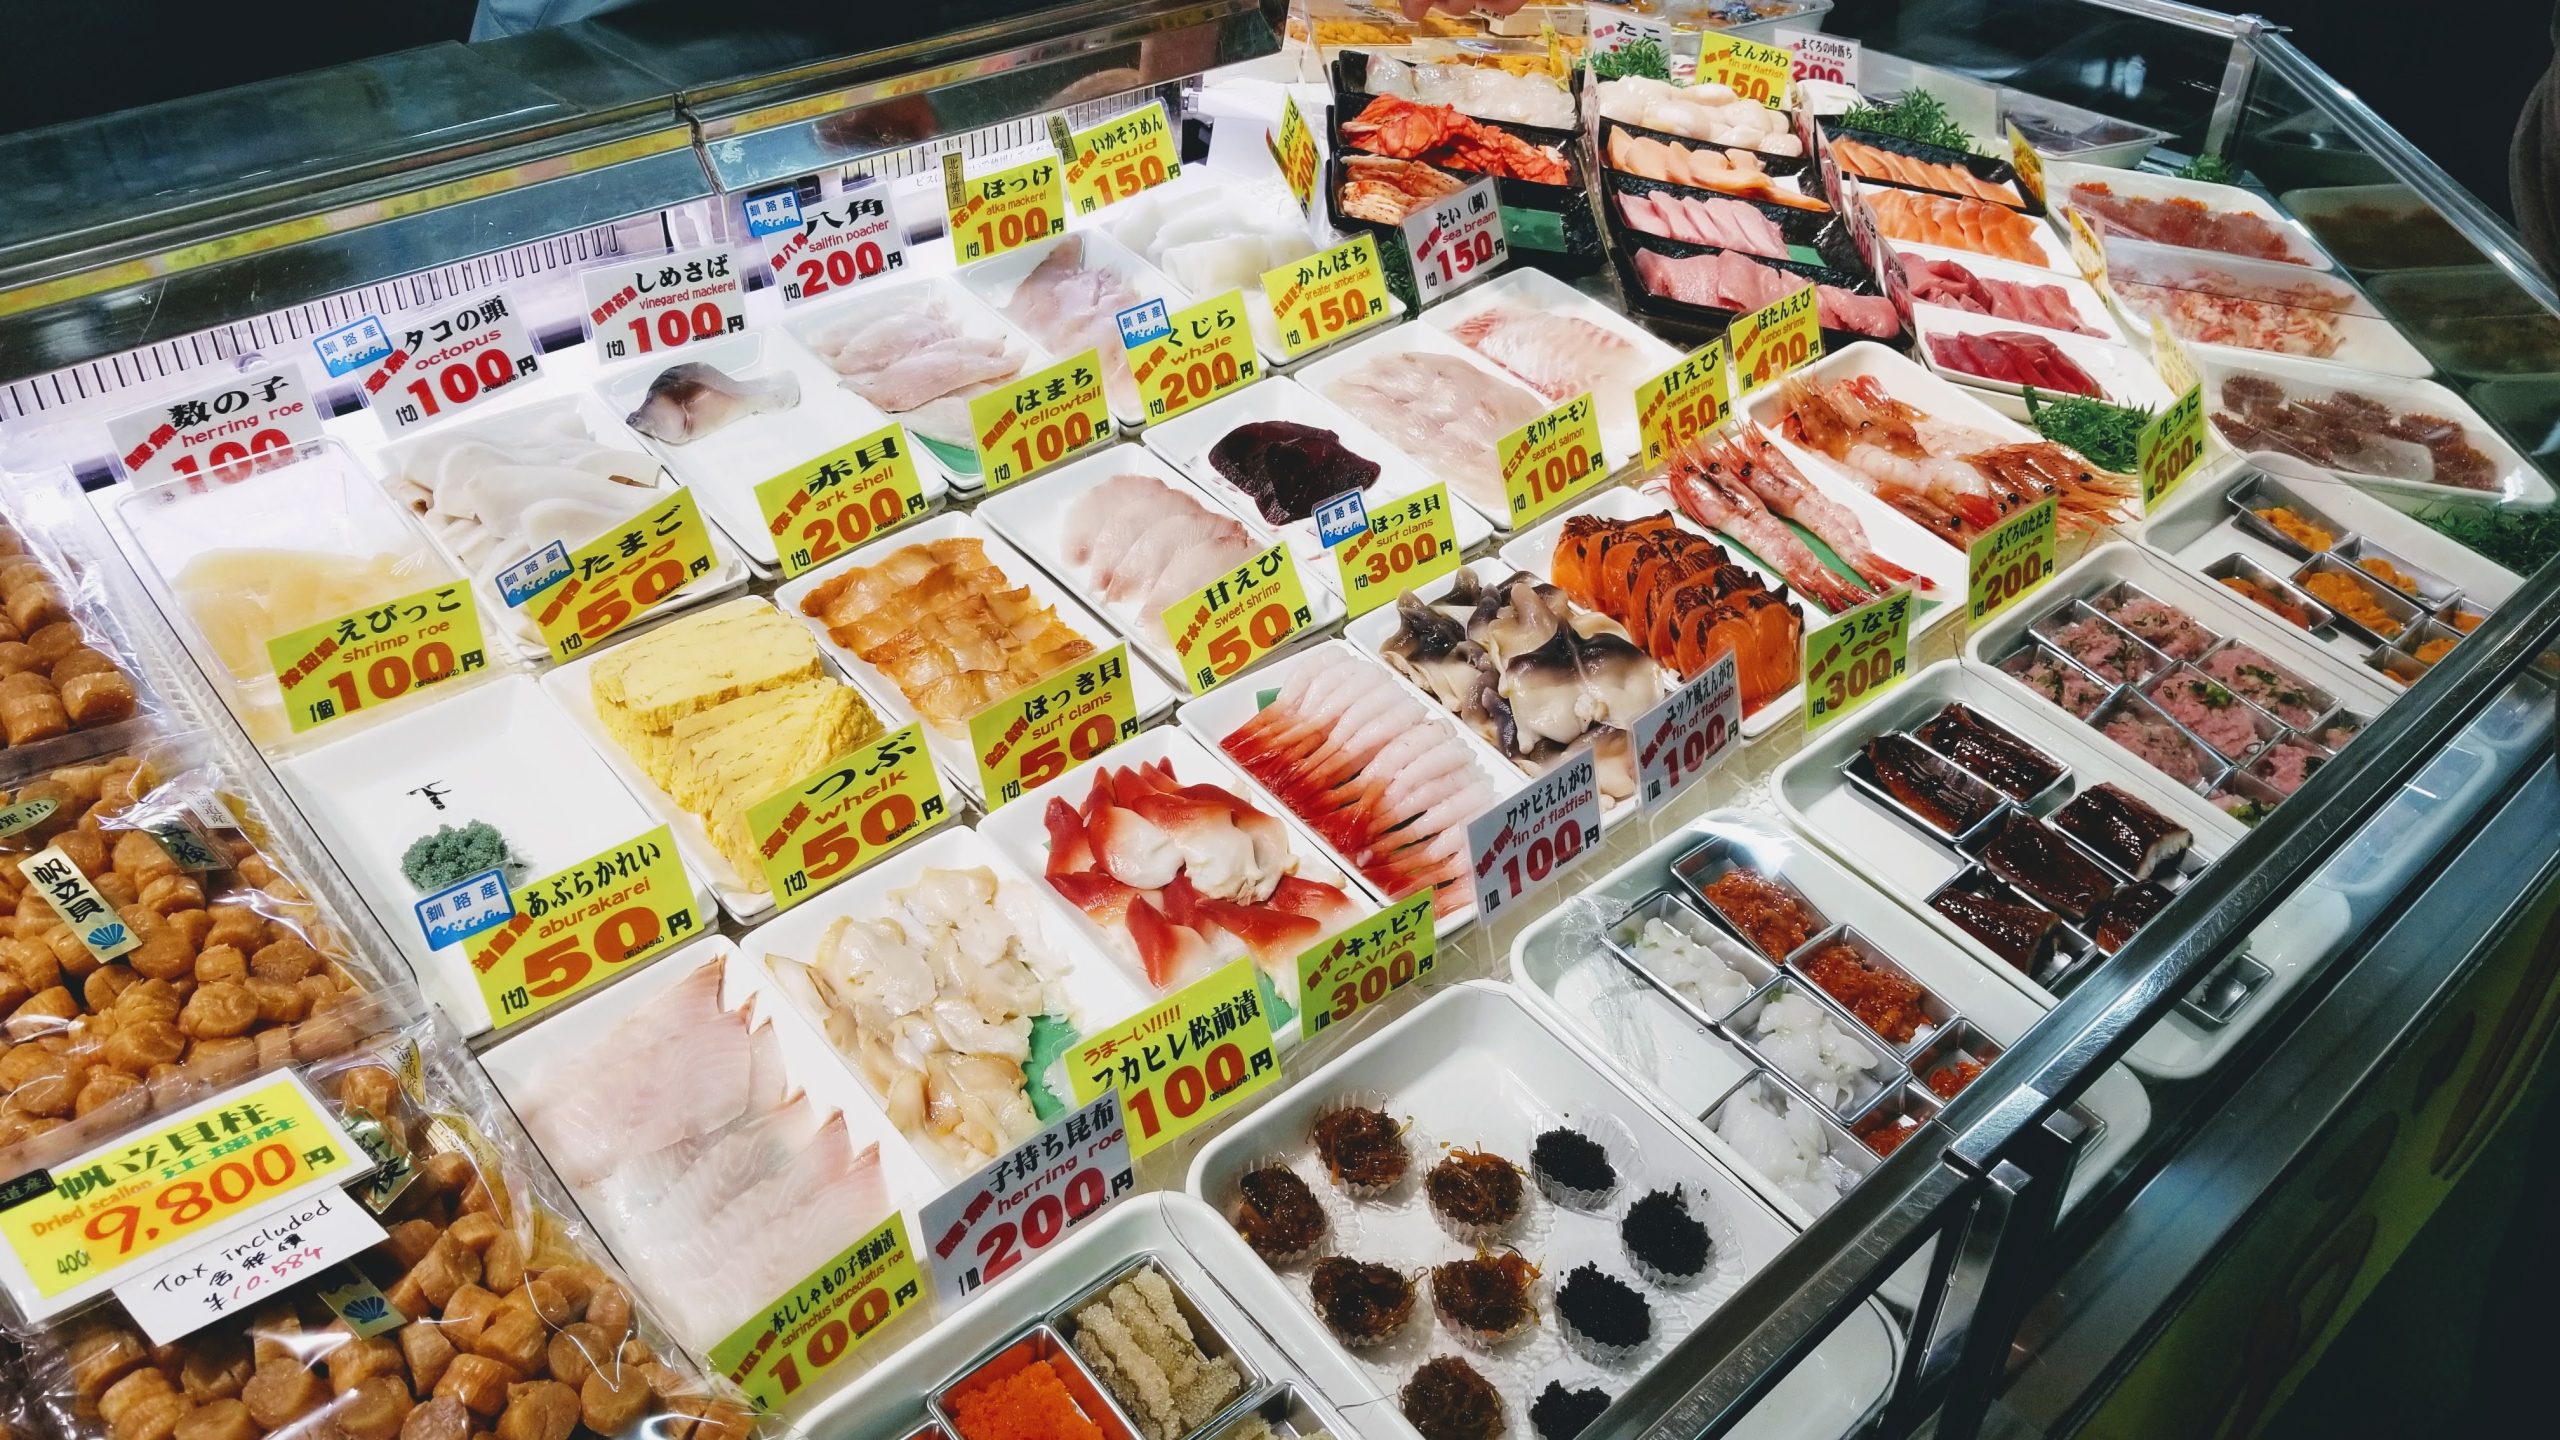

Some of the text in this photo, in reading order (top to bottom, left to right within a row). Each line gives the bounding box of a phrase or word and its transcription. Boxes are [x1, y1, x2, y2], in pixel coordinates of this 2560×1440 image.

[1730, 42, 1788, 67] えんがわ
[1803, 53, 1844, 66] tuna
[1091, 114, 1163, 154] いかそうめん
[1100, 138, 1157, 167] squid
[983, 165, 1053, 201] ほっけ
[987, 191, 1046, 216] atka mackerel
[805, 199, 884, 238] 八角
[809, 220, 889, 252] sailfin poacher
[1443, 211, 1496, 243] sea bream
[636, 254, 729, 293] しめさば
[1296, 246, 1367, 286] かんぱち
[640, 290, 689, 310] vinegared
[692, 279, 736, 299] mackerel
[405, 295, 509, 355] タコの頭
[1168, 309, 1236, 347] くじら
[415, 329, 501, 370] octopus
[1170, 335, 1232, 365] whale
[1662, 348, 1718, 395] 甘えび
[167, 375, 289, 432] 数の子
[1016, 368, 1093, 414] はまち
[1020, 385, 1101, 430] yellowtail
[182, 415, 258, 447] herring
[269, 401, 303, 420] roe
[1527, 399, 1588, 448] 炙りサーモン
[1532, 441, 1556, 462] seared
[1559, 427, 1584, 447] salmon
[806, 437, 899, 496] 赤貝
[816, 466, 893, 511] ark shell
[1372, 494, 1440, 534] ほっき貝
[1377, 519, 1433, 547] surf clams
[578, 505, 682, 581] たまご
[1998, 535, 2043, 566] tuna
[1203, 546, 1283, 612] 甘えび
[337, 589, 461, 645] えびっこ
[1215, 582, 1280, 628] sweet shrimp
[1840, 596, 1909, 646] うなぎ
[343, 633, 408, 664] shrimp
[418, 620, 449, 639] roe
[1851, 623, 1899, 656] eel
[1025, 657, 1121, 722] ほっき貝
[1032, 692, 1112, 740] surf clams
[1672, 686, 1734, 740] fin of flatfish
[805, 732, 916, 802] つぶ
[815, 770, 908, 824] whelk
[1507, 763, 1592, 831] ワサビえんがわ
[1512, 790, 1592, 848] fin of flatfish
[426, 880, 499, 923] 釧路産
[526, 843, 660, 918] あぶらかれい
[539, 877, 650, 938] aburakarei
[1346, 901, 1430, 957] キャビア
[1334, 932, 1416, 981] CAVIAR
[989, 1099, 1113, 1193] 子持ち昆布
[997, 1128, 1123, 1216] herring roe
[31, 1205, 85, 1237] Dried
[154, 1200, 332, 1293] Tax included
[782, 1250, 904, 1347] spirinchus lanceolatus roe
